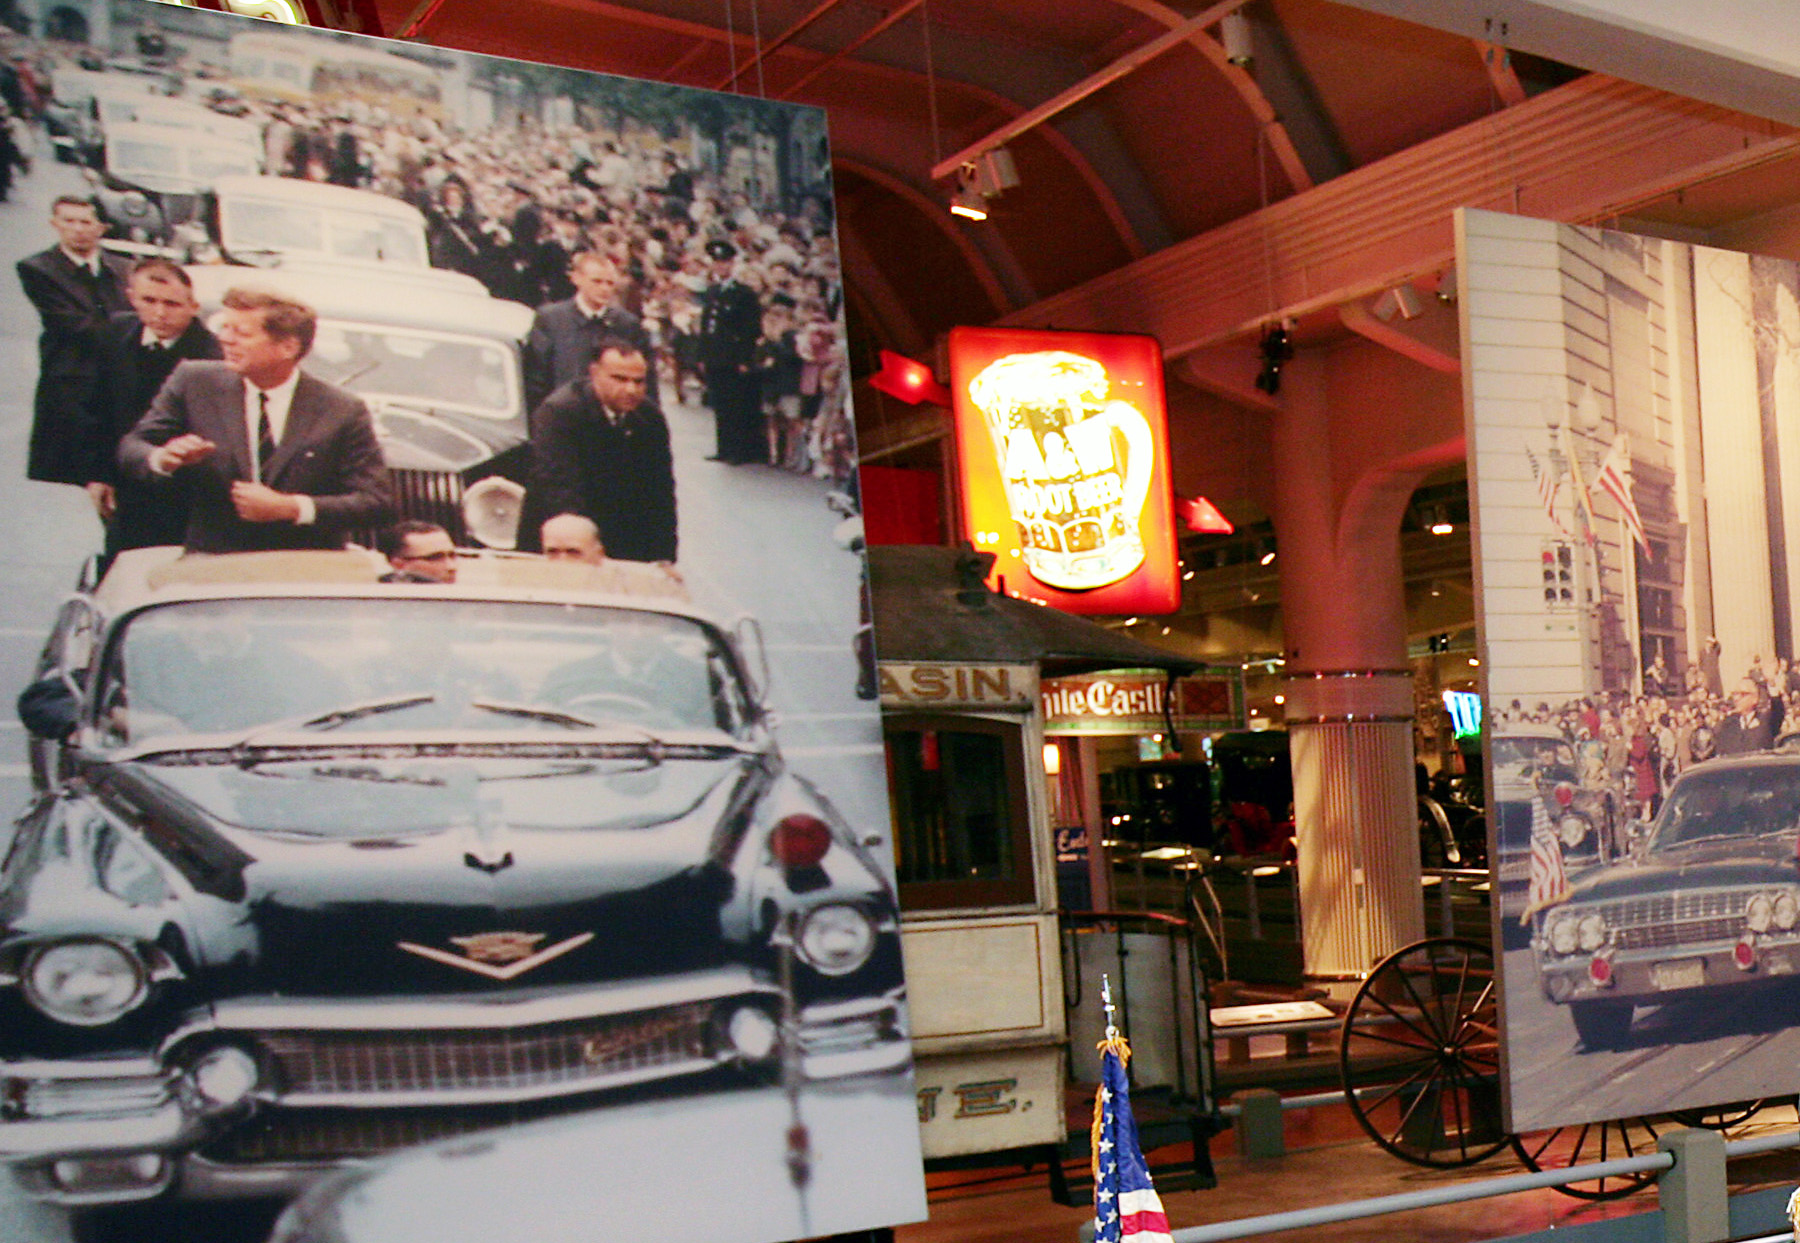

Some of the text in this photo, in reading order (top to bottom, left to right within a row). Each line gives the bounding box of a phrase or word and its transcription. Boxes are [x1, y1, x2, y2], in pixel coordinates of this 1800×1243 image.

[1004, 411, 1115, 480] A&W
[1010, 472, 1123, 521] ROOT BEER
